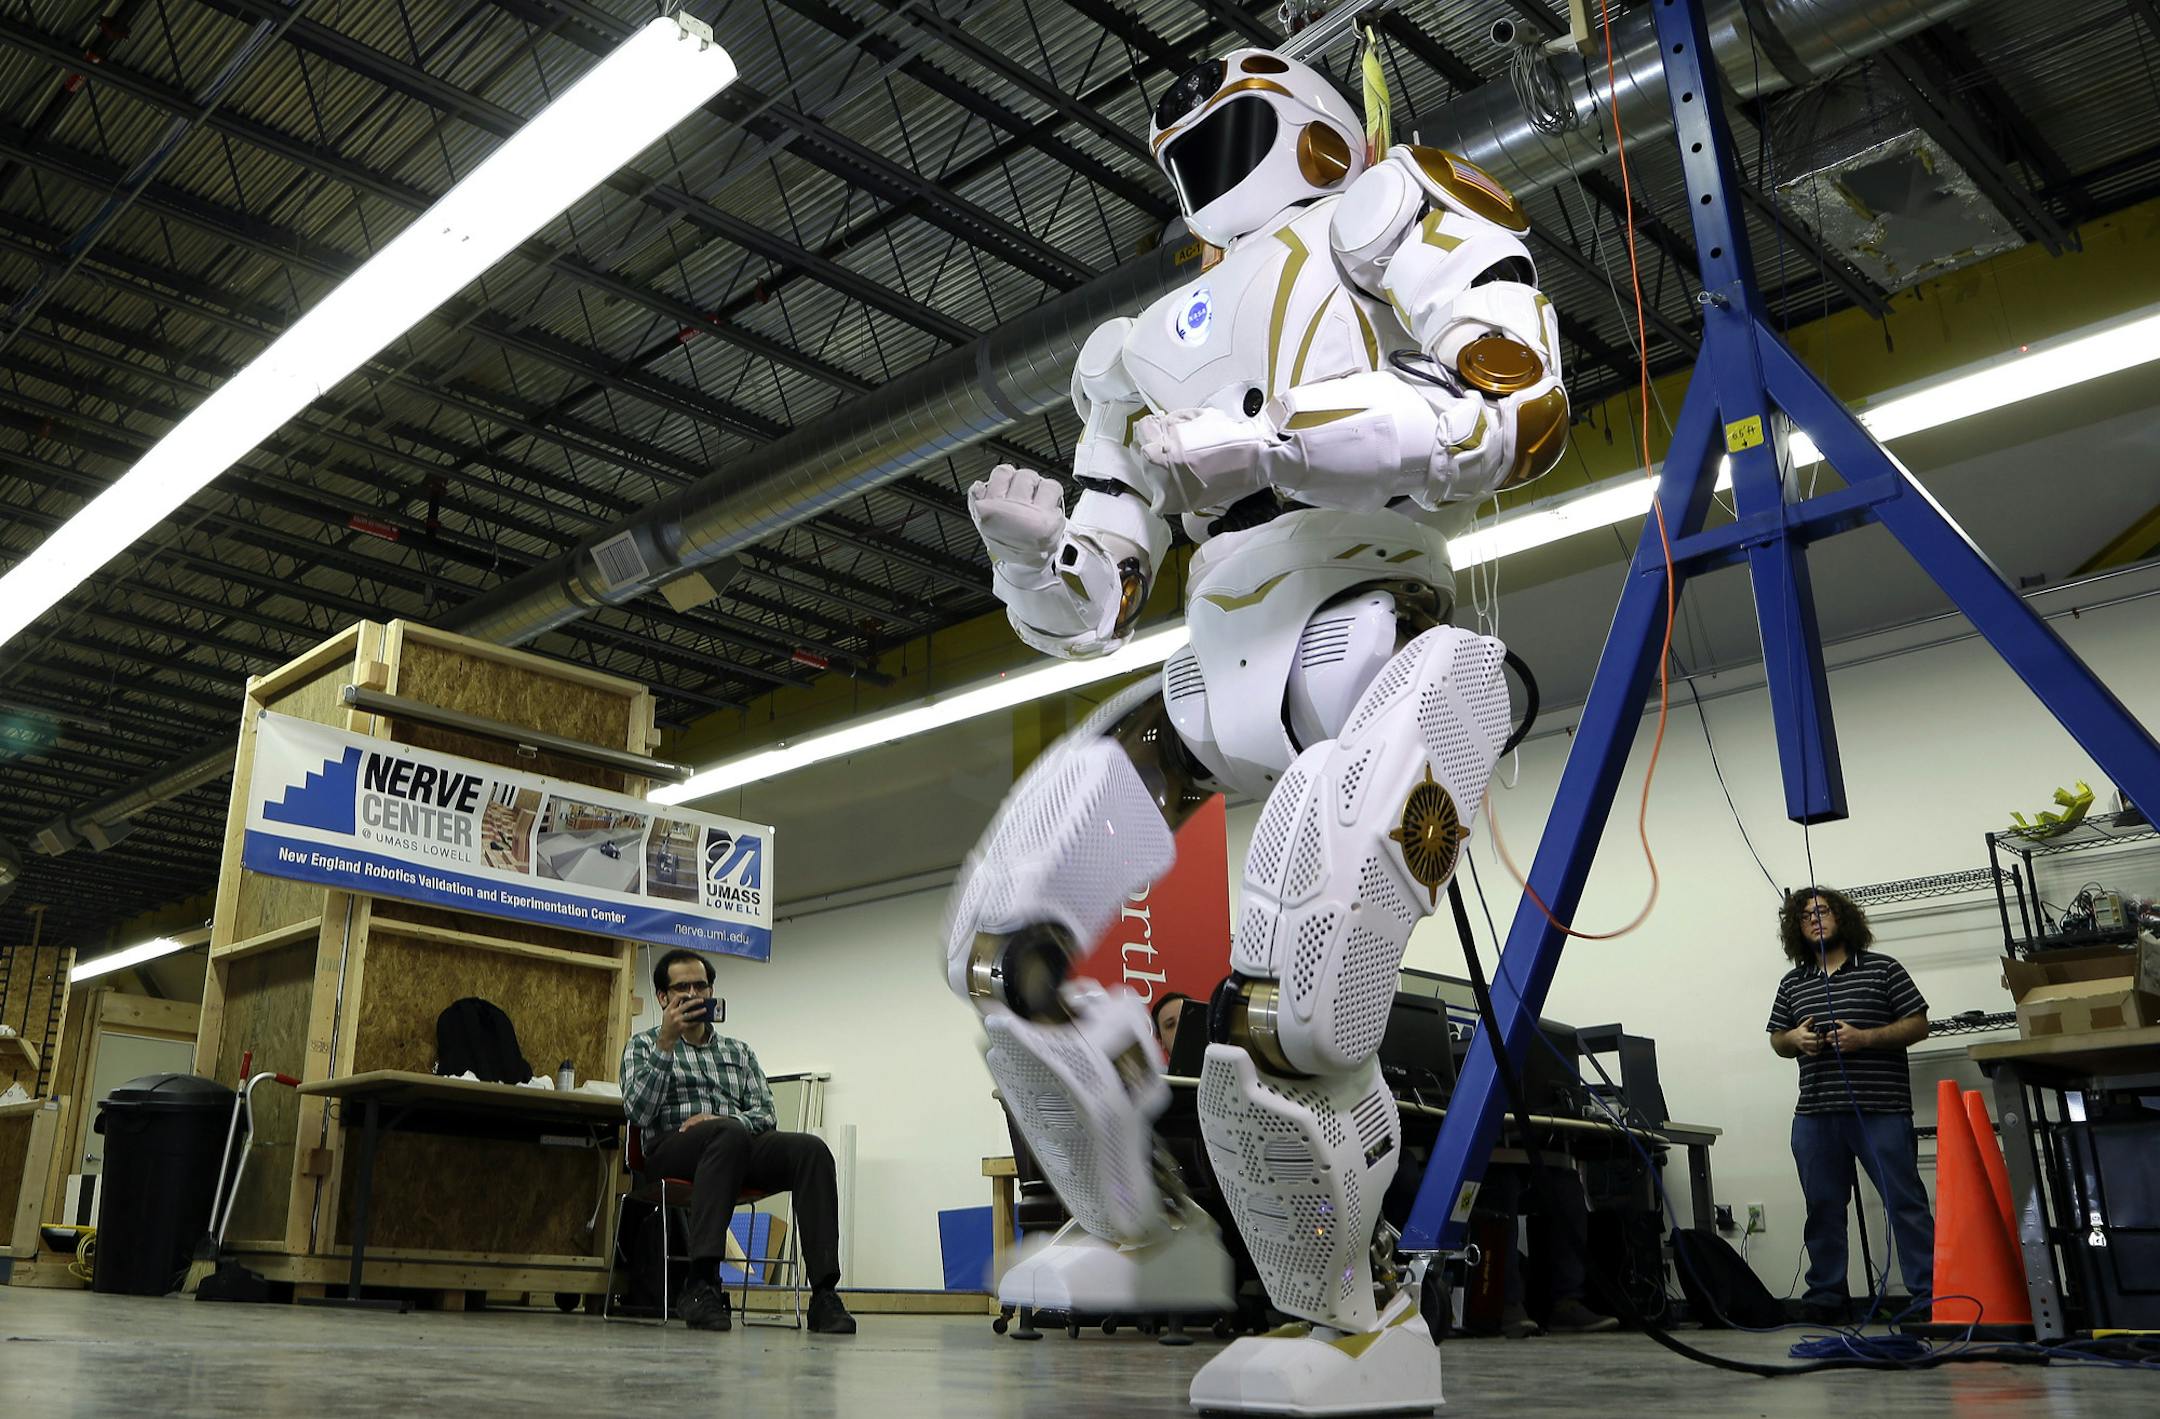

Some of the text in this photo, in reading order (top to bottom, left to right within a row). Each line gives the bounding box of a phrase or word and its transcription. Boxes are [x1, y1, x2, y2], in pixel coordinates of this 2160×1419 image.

[364, 752, 483, 814] NERVE
[362, 793, 472, 847] CENTER
[376, 832, 418, 851] UMASS
[423, 844, 471, 862] LOWELL
[279, 847, 627, 924] New England Robotics Validation and Experimentation Center
[706, 883, 761, 905] UMASS
[706, 898, 760, 916] LOWELL
[674, 923, 750, 945] nerve.uml.edu
